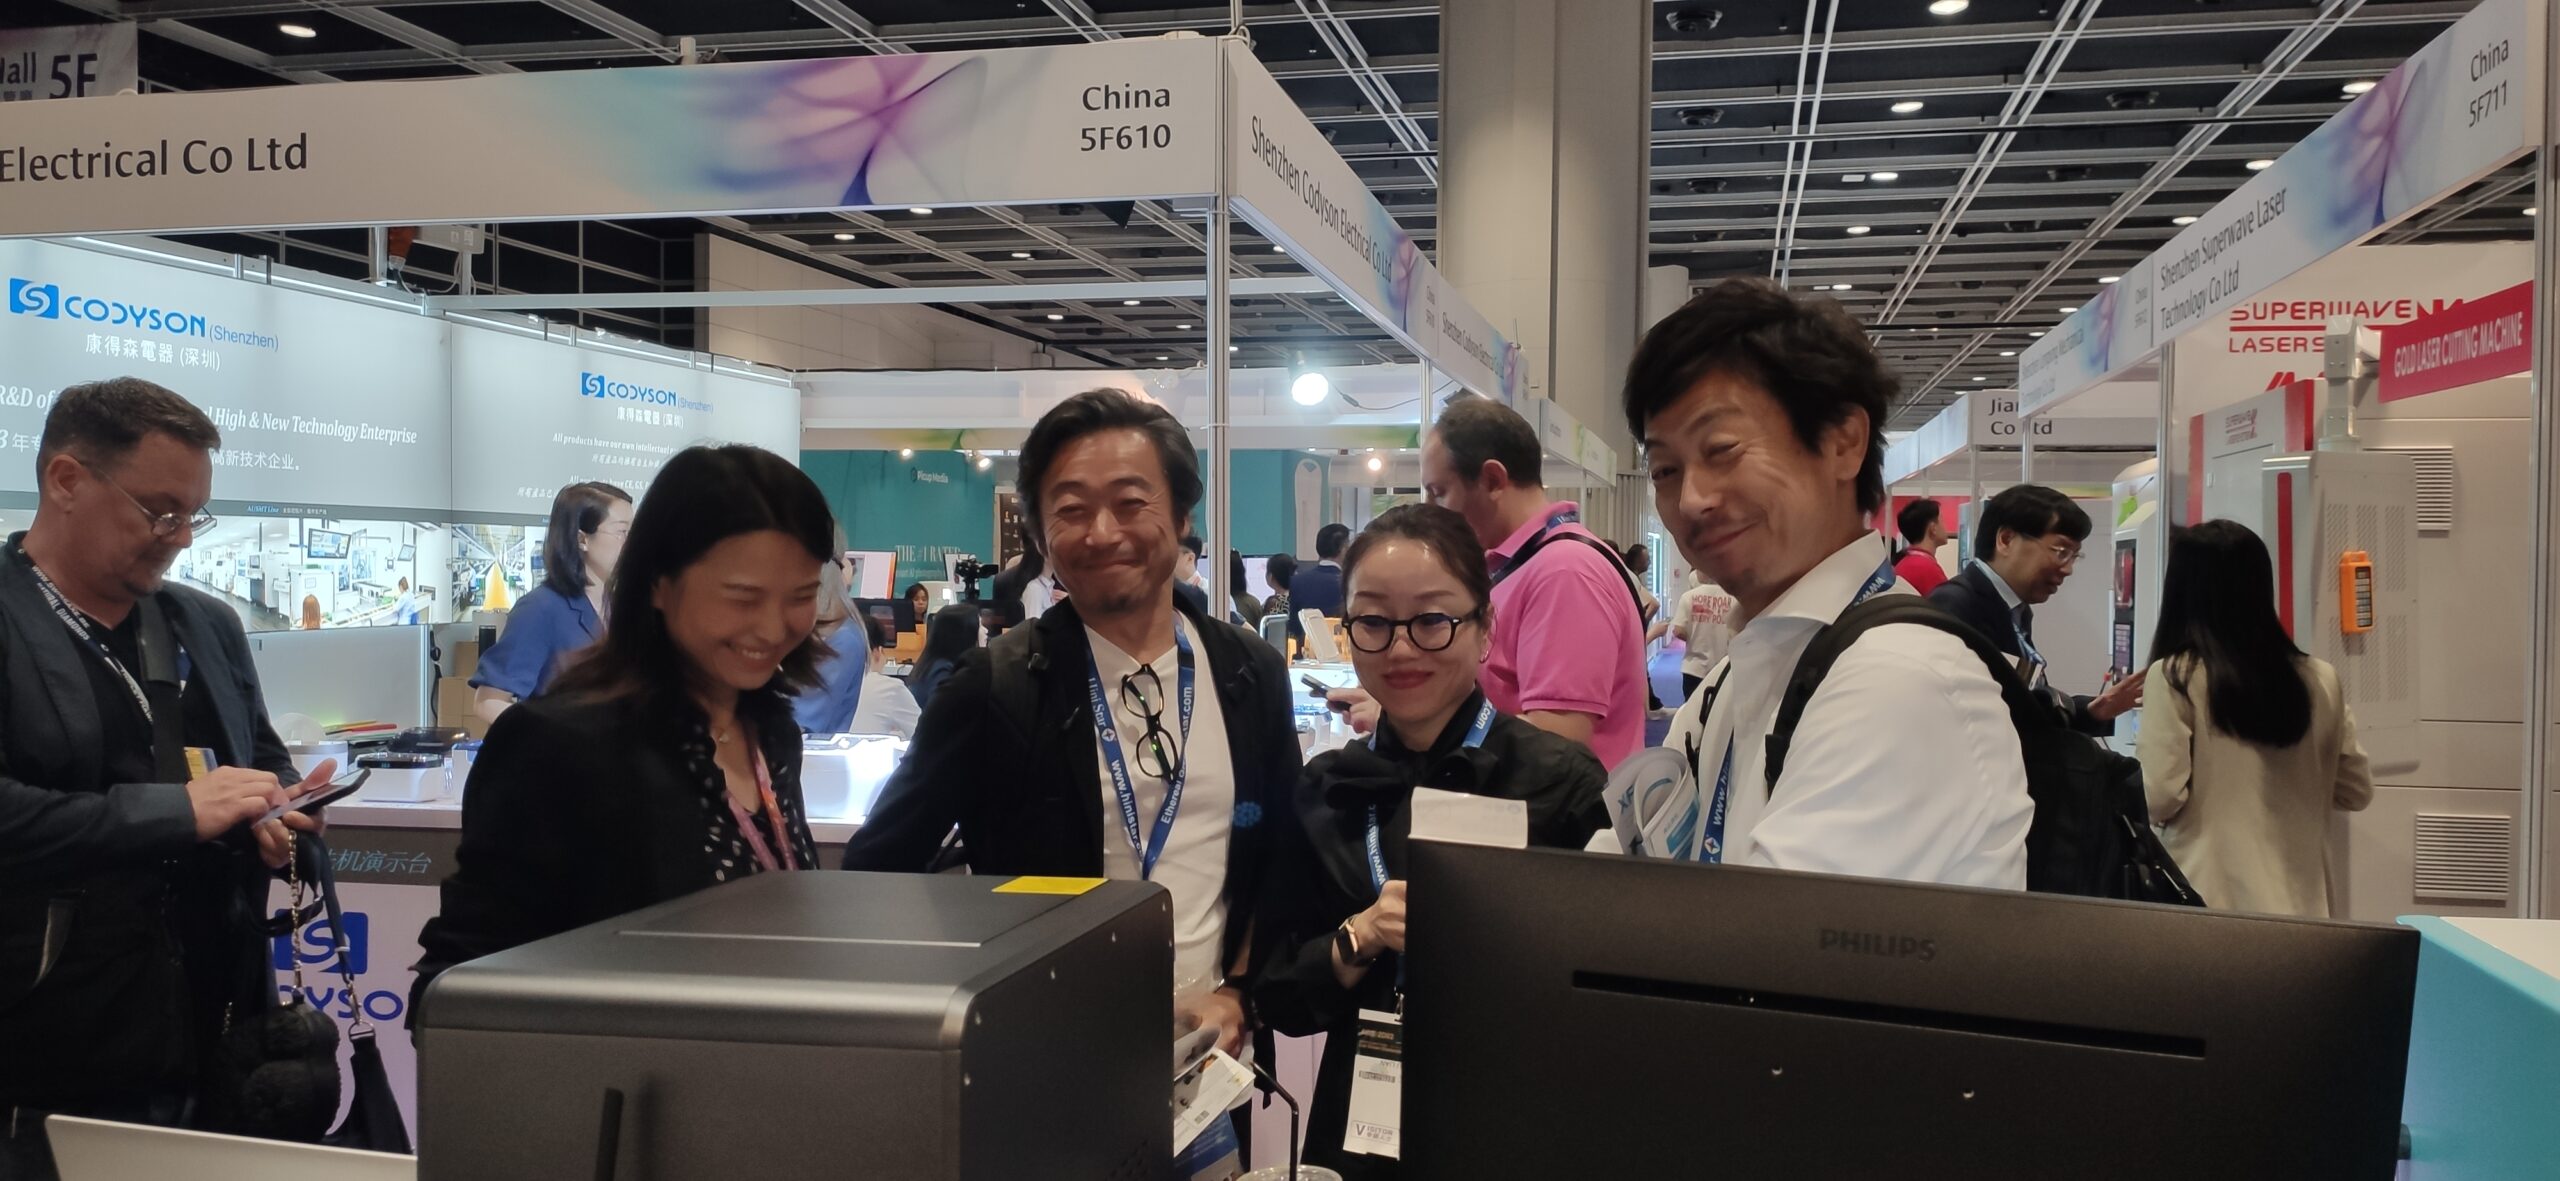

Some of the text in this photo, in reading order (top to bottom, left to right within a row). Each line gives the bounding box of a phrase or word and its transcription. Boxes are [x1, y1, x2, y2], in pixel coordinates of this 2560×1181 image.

[50, 53, 98, 98] 5F
[2470, 39, 2509, 82] China
[1082, 83, 1170, 111] China
[2469, 79, 2507, 128] 5F711
[0, 132, 307, 182] Electrical Co Ltd
[1081, 124, 1171, 151] 5F610
[1251, 115, 1392, 283] Shenzhen Codyson Electrical Co Ltd
[2160, 187, 2287, 291] Shenzhen Superwave Laser
[2161, 287, 2207, 331] Technology
[2209, 276, 2221, 304] Co
[2223, 260, 2239, 296] Ltd
[64, 296, 279, 350] CODYSON (Shenzhen)
[2394, 311, 2523, 377] GOLD LASER CUTTING MACHINE
[85, 333, 221, 371] 康得森電器 (深圳)
[0, 385, 33, 407] R&D
[214, 407, 246, 431] High
[249, 410, 260, 428] &
[262, 412, 290, 432] New
[292, 415, 358, 443] Technology
[360, 423, 417, 446] Enterprise
[607, 382, 677, 406] CODYSON
[552, 432, 563, 442] All
[564, 435, 592, 446] products
[594, 437, 609, 447] have
[610, 441, 621, 449] our
[622, 442, 635, 450] own
[1990, 420, 2053, 435] Co td
[896, 545, 916, 562] THE
[56, 608, 91, 641] DIAMONDS
[1111, 759, 1144, 862] www.hinistar.c
[1161, 780, 1182, 824] Ethereal
[1819, 928, 1937, 964] PHILIPS
[1356, 1123, 1393, 1137] VISITOR
